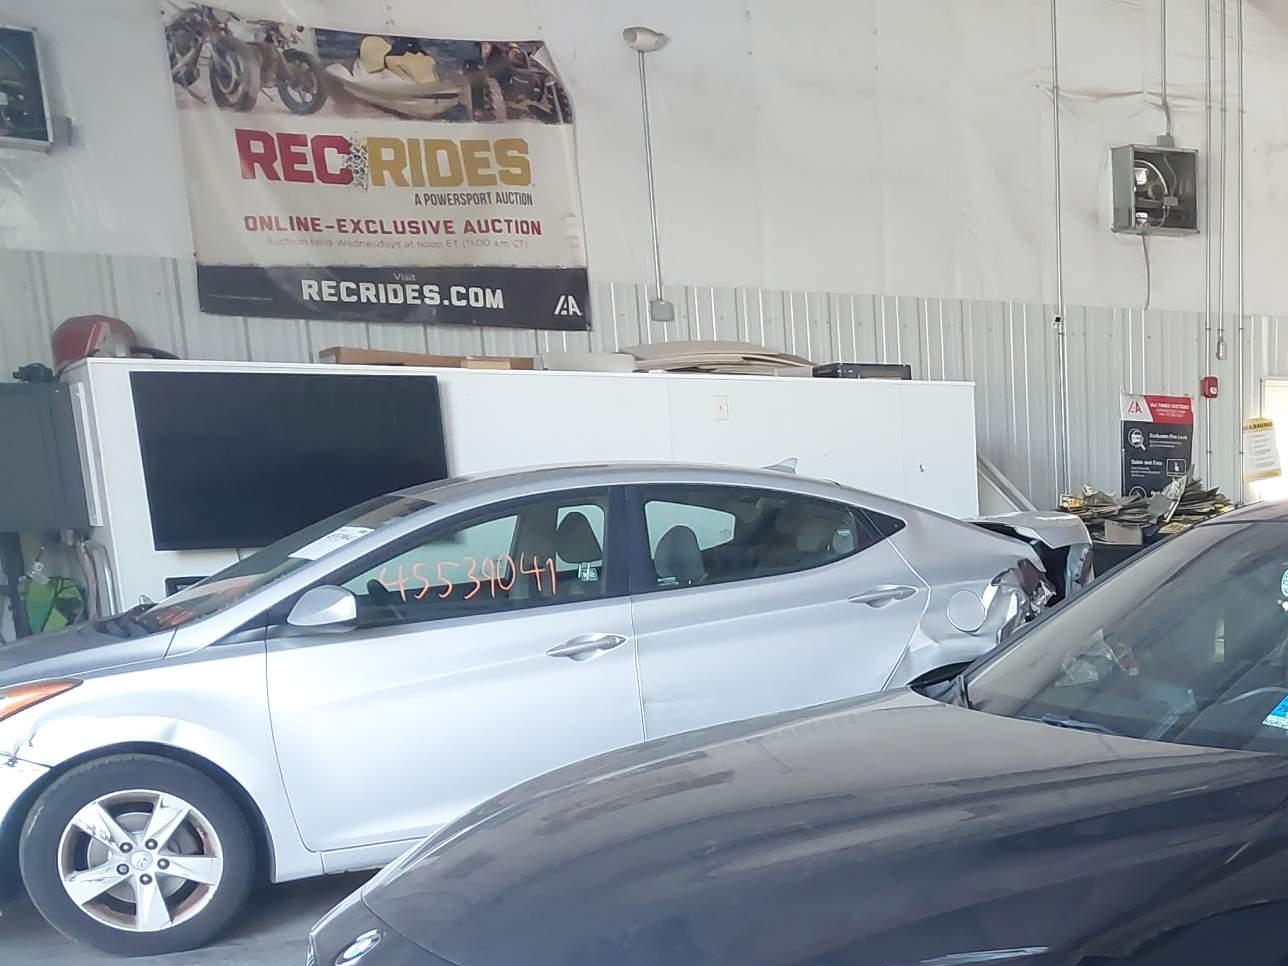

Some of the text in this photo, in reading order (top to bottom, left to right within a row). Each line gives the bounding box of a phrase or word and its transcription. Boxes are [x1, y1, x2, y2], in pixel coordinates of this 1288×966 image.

[235, 129, 531, 187] REC RIDES
[414, 191, 533, 207] A POWERSPORT AUCTION
[244, 215, 542, 236] ONLINE-EXCLUSIVE AUCTION
[392, 271, 416, 281] Visit
[301, 279, 504, 309] RECRIDES.COM
